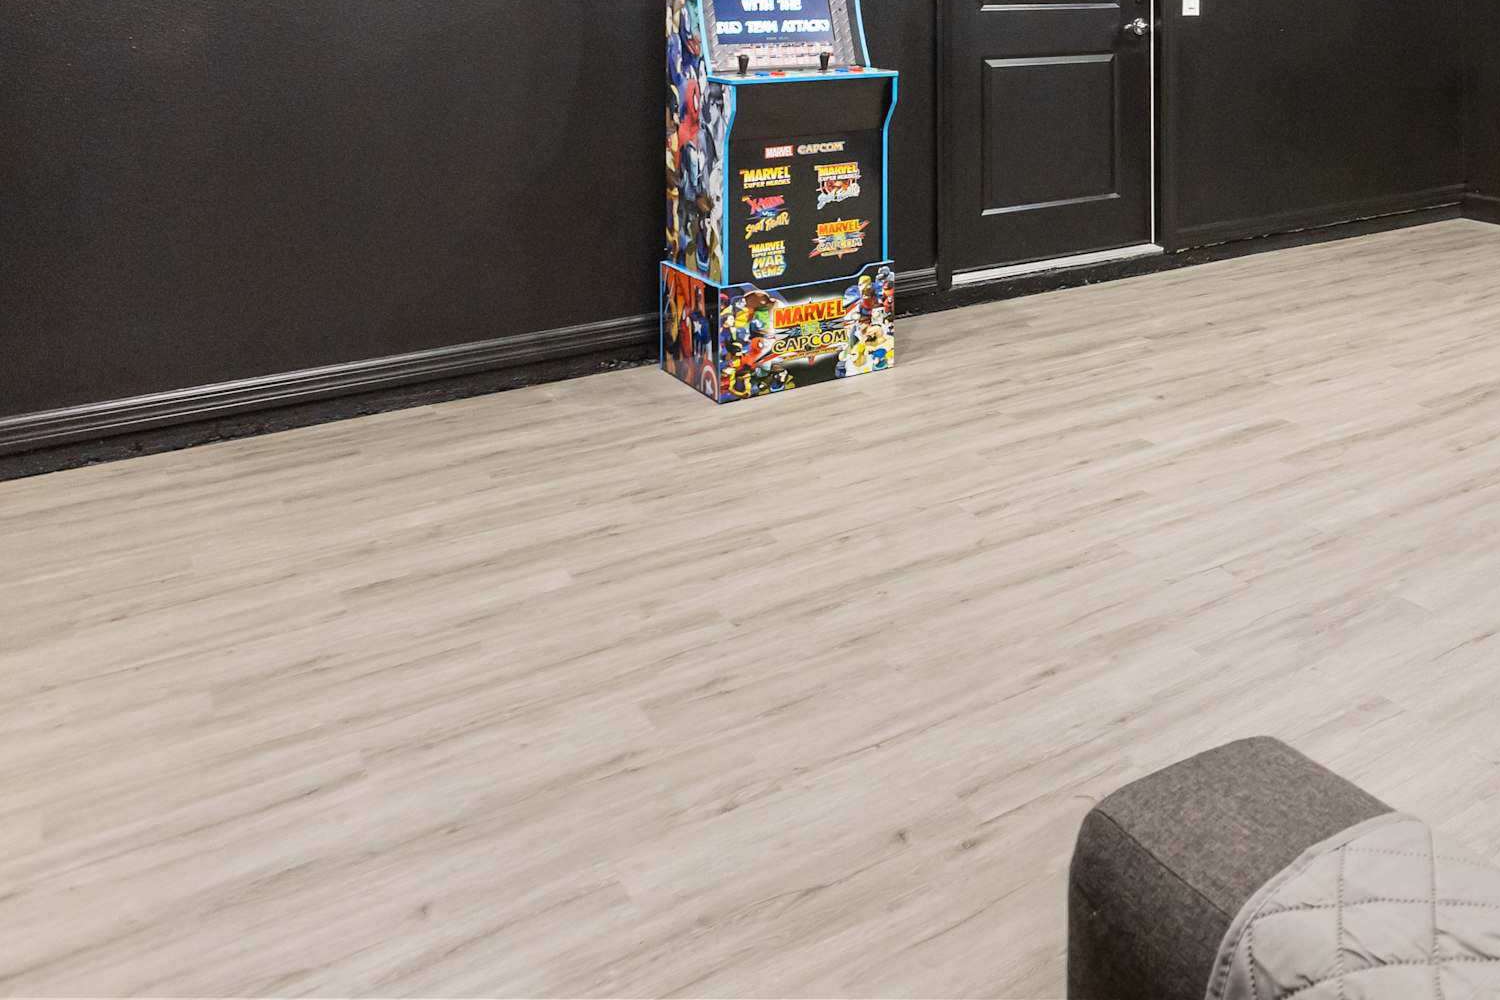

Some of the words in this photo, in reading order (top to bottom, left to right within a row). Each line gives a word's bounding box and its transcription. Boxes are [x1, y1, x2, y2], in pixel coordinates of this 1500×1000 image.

[765, 145, 793, 159] MARVEL
[797, 141, 845, 155] CAPCOM
[741, 165, 791, 183] MARVEL
[818, 164, 858, 177] MARVEL
[818, 219, 861, 236] MARVEL
[749, 240, 785, 254] MARVEL
[752, 254, 785, 270] WAR
[774, 299, 845, 328] MARVEL
[772, 329, 848, 354] CAPCOM
